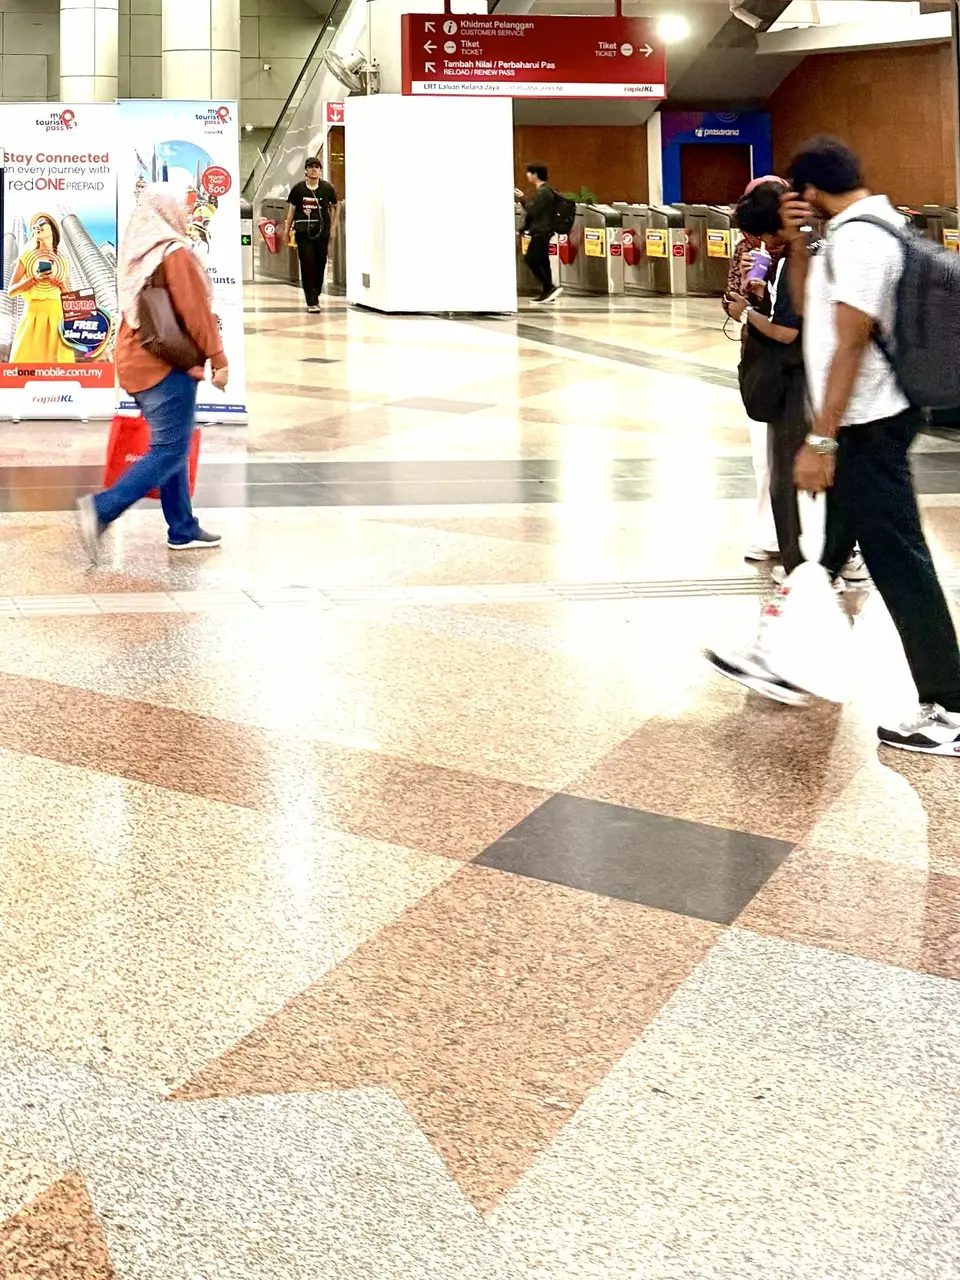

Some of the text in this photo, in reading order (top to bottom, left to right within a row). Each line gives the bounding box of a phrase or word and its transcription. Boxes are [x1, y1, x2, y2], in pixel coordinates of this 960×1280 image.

[494, 21, 535, 30] Pelanggan
[460, 40, 480, 48] Tiket
[598, 41, 617, 50] Tiket
[443, 59, 474, 68] Tambah
[475, 60, 493, 68] Nilai
[498, 61, 540, 69] Perbaharui
[541, 61, 556, 69] Pas
[207, 108, 219, 116] my
[704, 129, 739, 137] prasarana
[3, 152, 109, 165] Stay Connected
[3, 165, 110, 176] on every journey with
[66, 182, 105, 191] PREPAID
[63, 300, 96, 310] ULTRA
[73, 320, 99, 330] FREE
[2, 367, 103, 379] redonemobile.com.my
[32, 394, 74, 404] rapidKL
